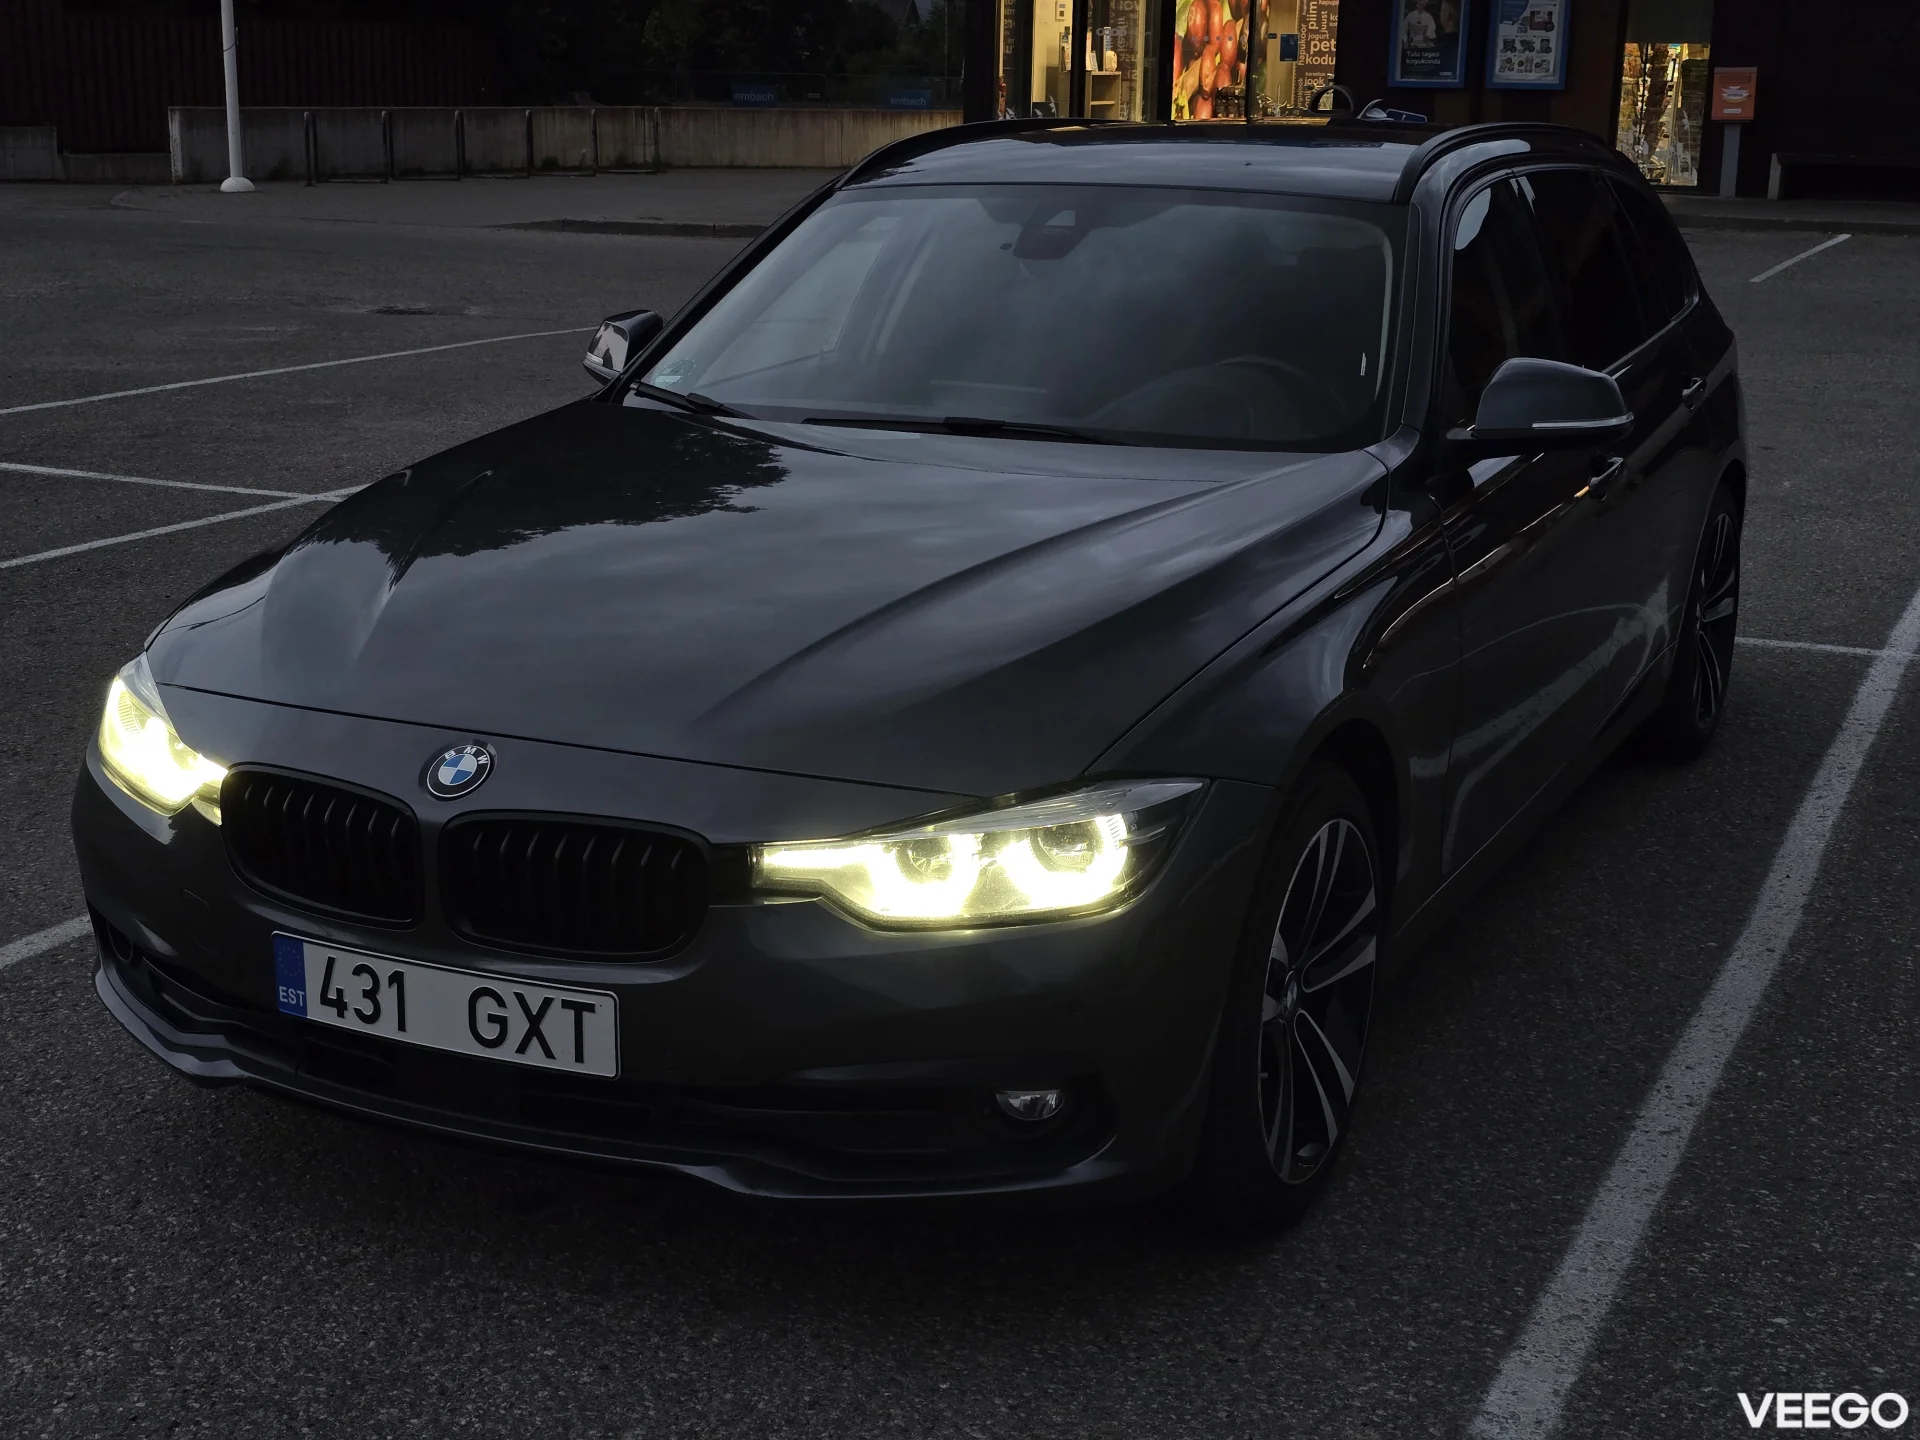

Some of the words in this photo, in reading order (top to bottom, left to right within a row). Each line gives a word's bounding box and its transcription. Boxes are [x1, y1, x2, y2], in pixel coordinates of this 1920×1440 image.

[1306, 1, 1319, 29] piim
[1319, 10, 1328, 33] juust
[1297, 22, 1307, 65] hapukoor
[1307, 32, 1329, 41] jogurt
[1406, 58, 1440, 66] kogukonda
[734, 89, 774, 101] embach
[444, 746, 488, 765] BMW
[279, 985, 305, 1008] EST
[320, 955, 408, 1033] 431
[467, 985, 597, 1064] GXT
